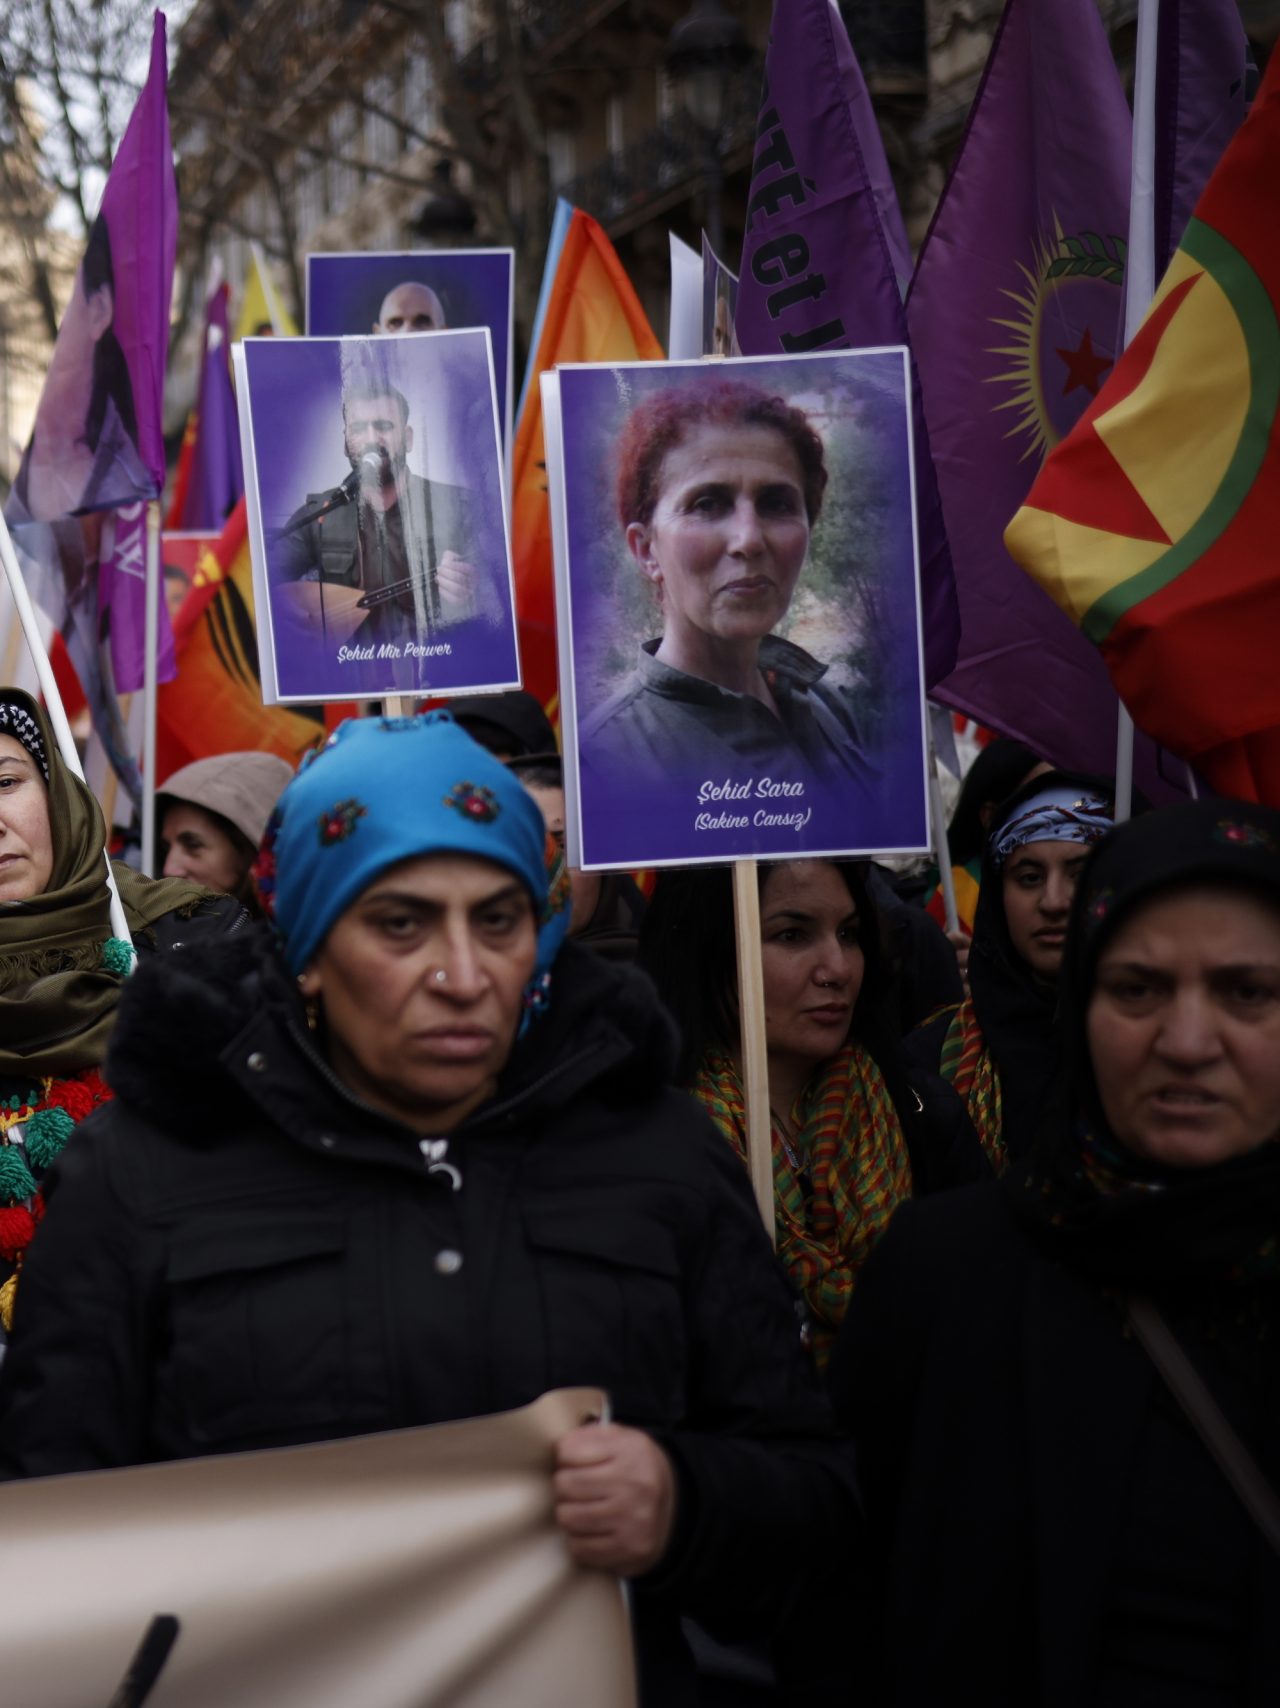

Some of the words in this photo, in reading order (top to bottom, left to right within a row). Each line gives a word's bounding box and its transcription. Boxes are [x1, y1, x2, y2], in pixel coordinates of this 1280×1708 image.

[337, 645, 375, 664] Şehid
[403, 641, 452, 658] Perwer
[697, 778, 753, 805] Şehid
[754, 777, 804, 798] Sara
[694, 810, 749, 832] (Sakine
[753, 807, 812, 832] Cansız)
